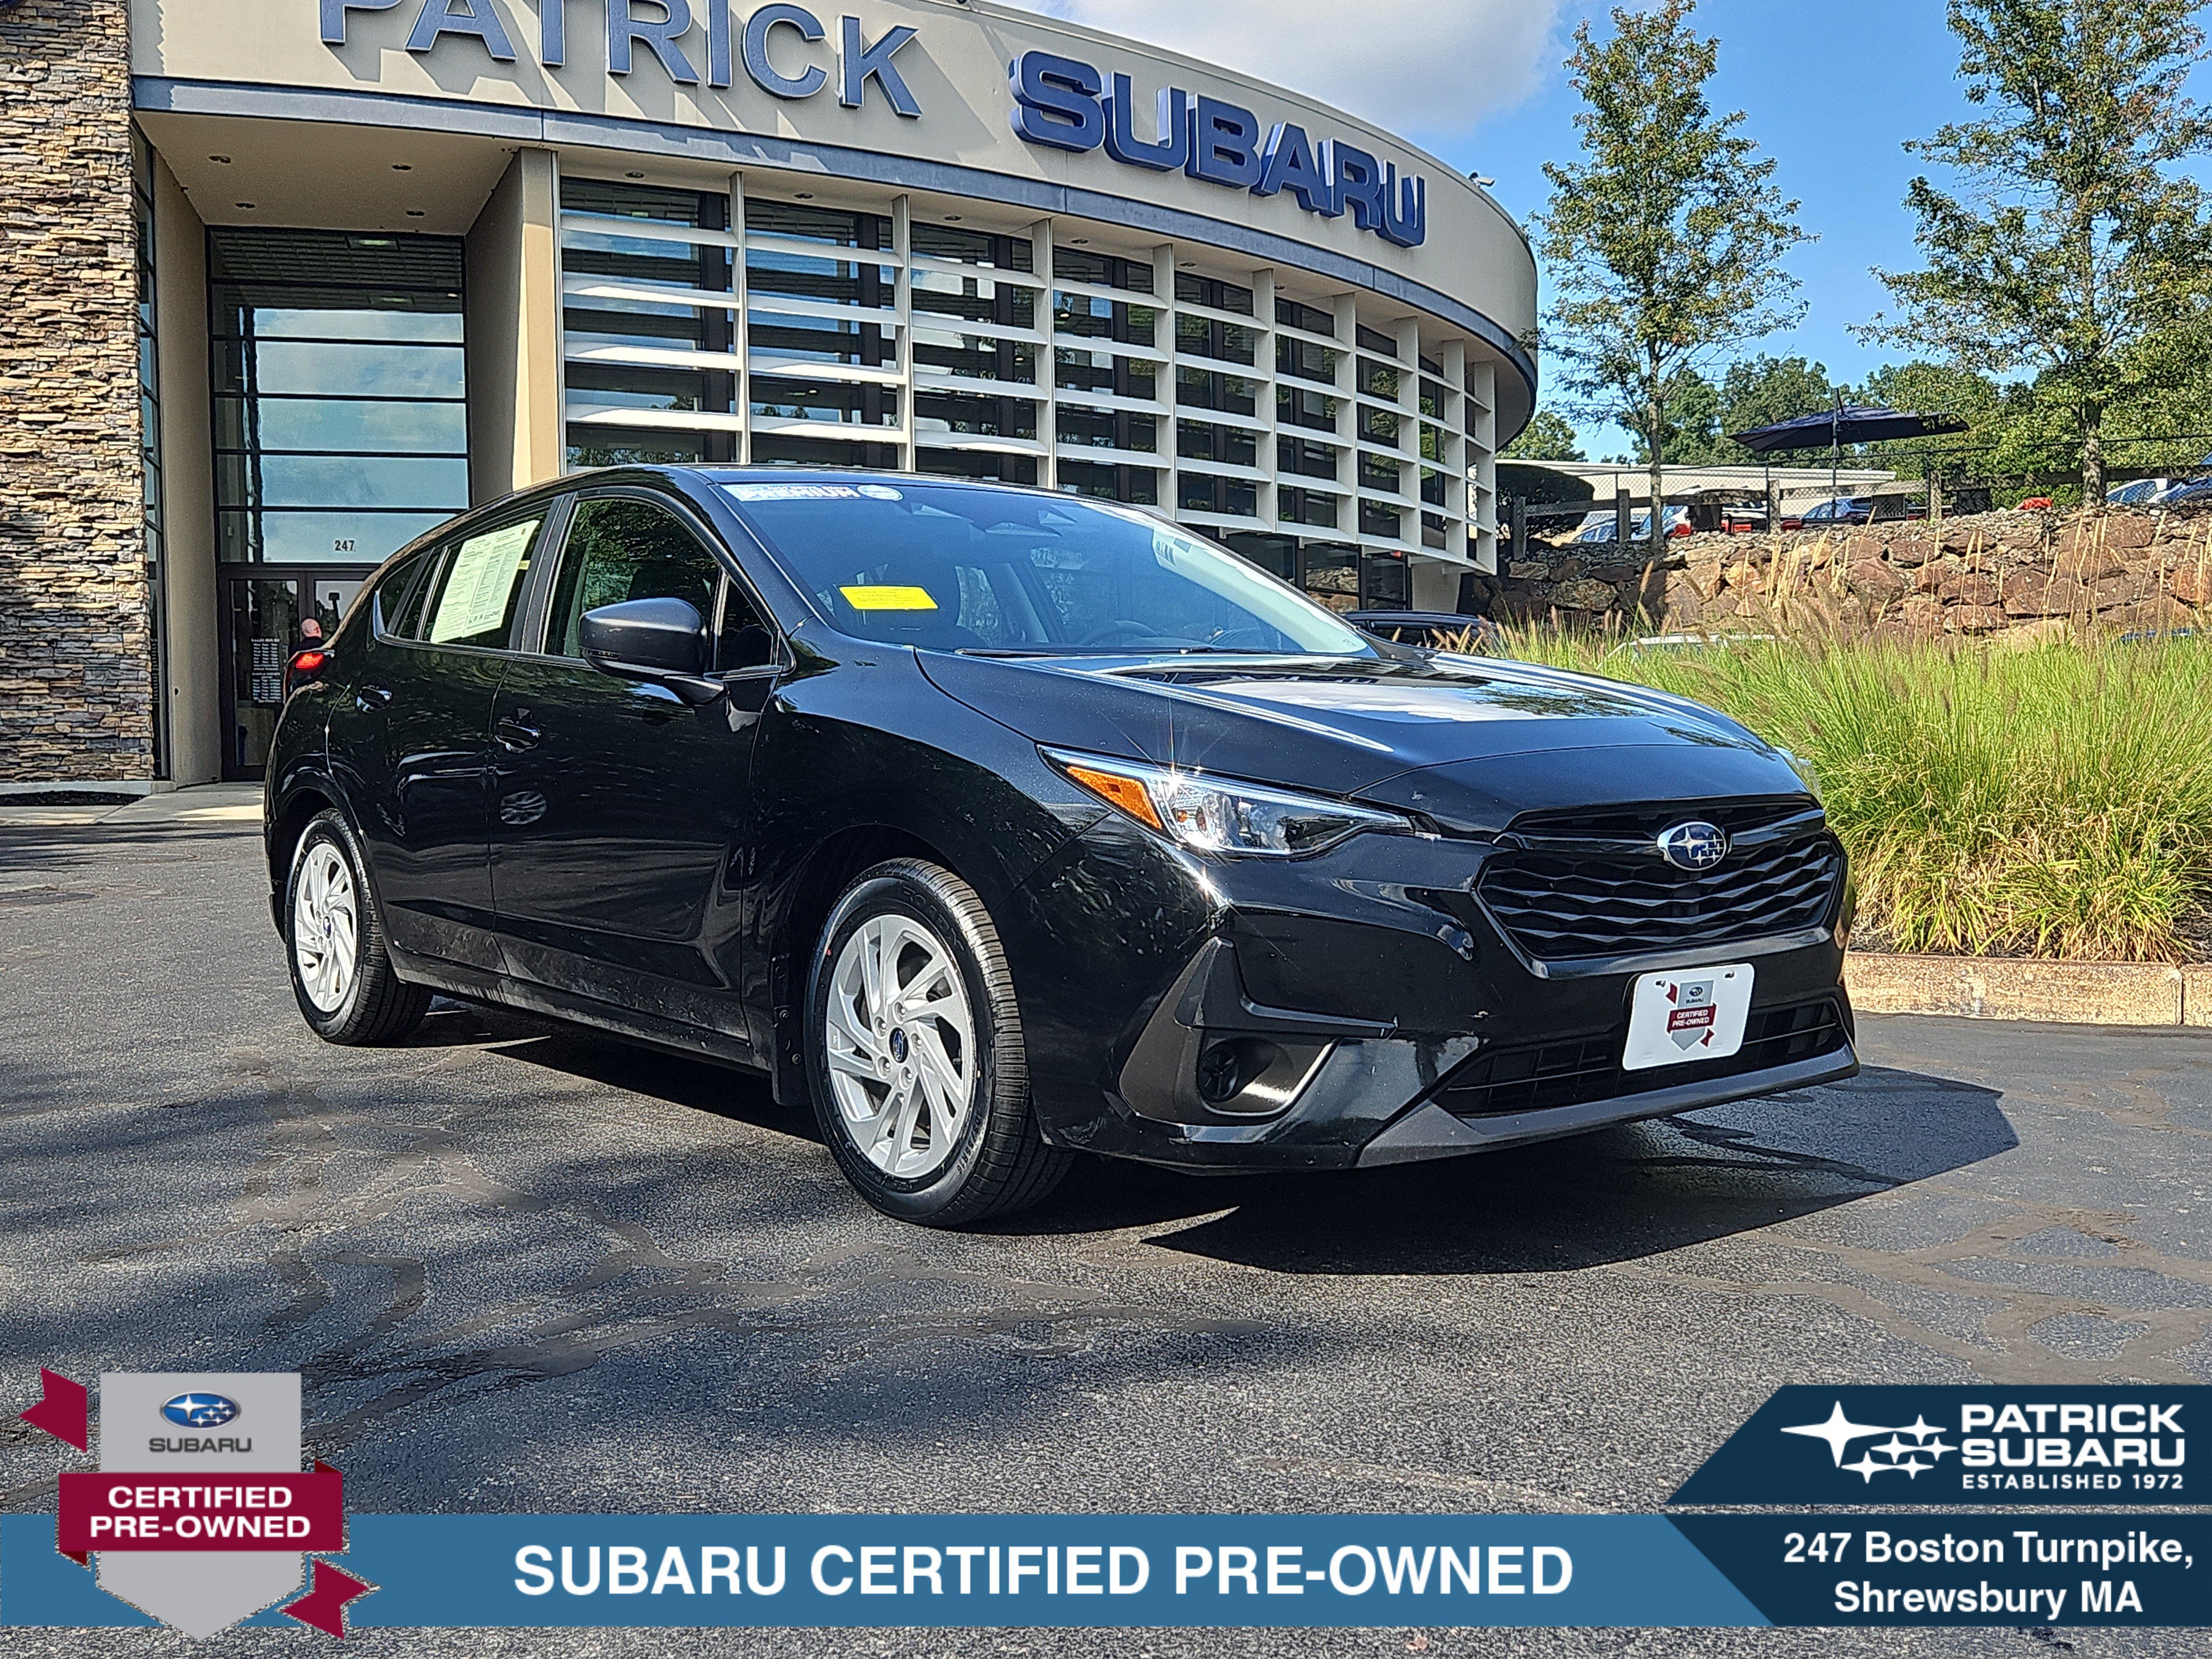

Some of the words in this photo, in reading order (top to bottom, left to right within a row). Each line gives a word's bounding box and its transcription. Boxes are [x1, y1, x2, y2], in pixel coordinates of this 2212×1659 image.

[1008, 50, 1426, 248] SUBARU
[335, 539, 355, 551] 247
[1677, 1009, 1708, 1019] CERTIFIED
[1672, 1017, 1709, 1027] PRE-OWNED
